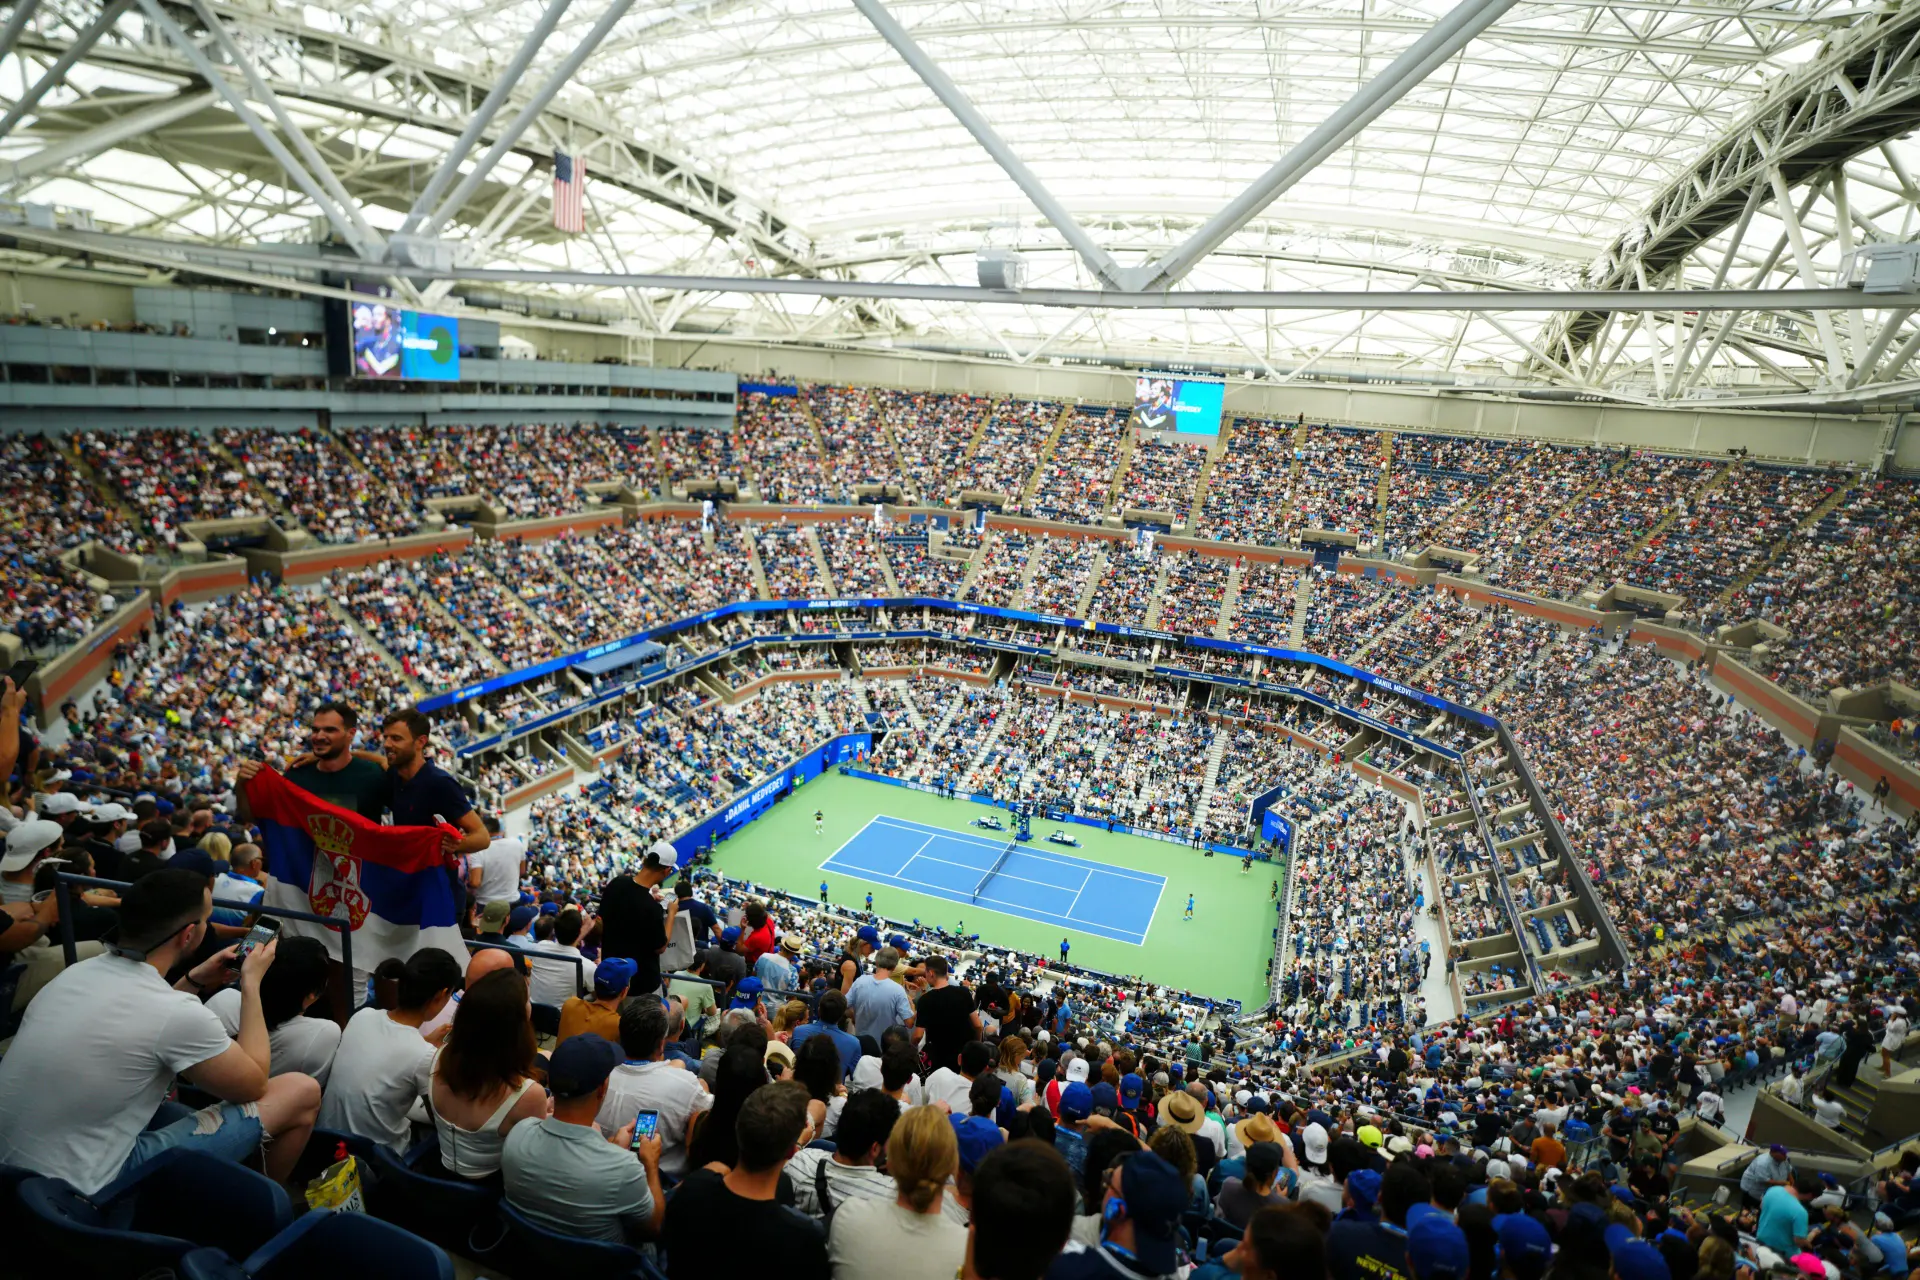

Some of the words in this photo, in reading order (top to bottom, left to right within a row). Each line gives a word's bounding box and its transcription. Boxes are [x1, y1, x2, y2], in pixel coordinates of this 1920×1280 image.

[1375, 678, 1393, 690] DANIIL
[728, 798, 751, 820] DANIIL
[751, 775, 784, 805] MEDVEDEV
